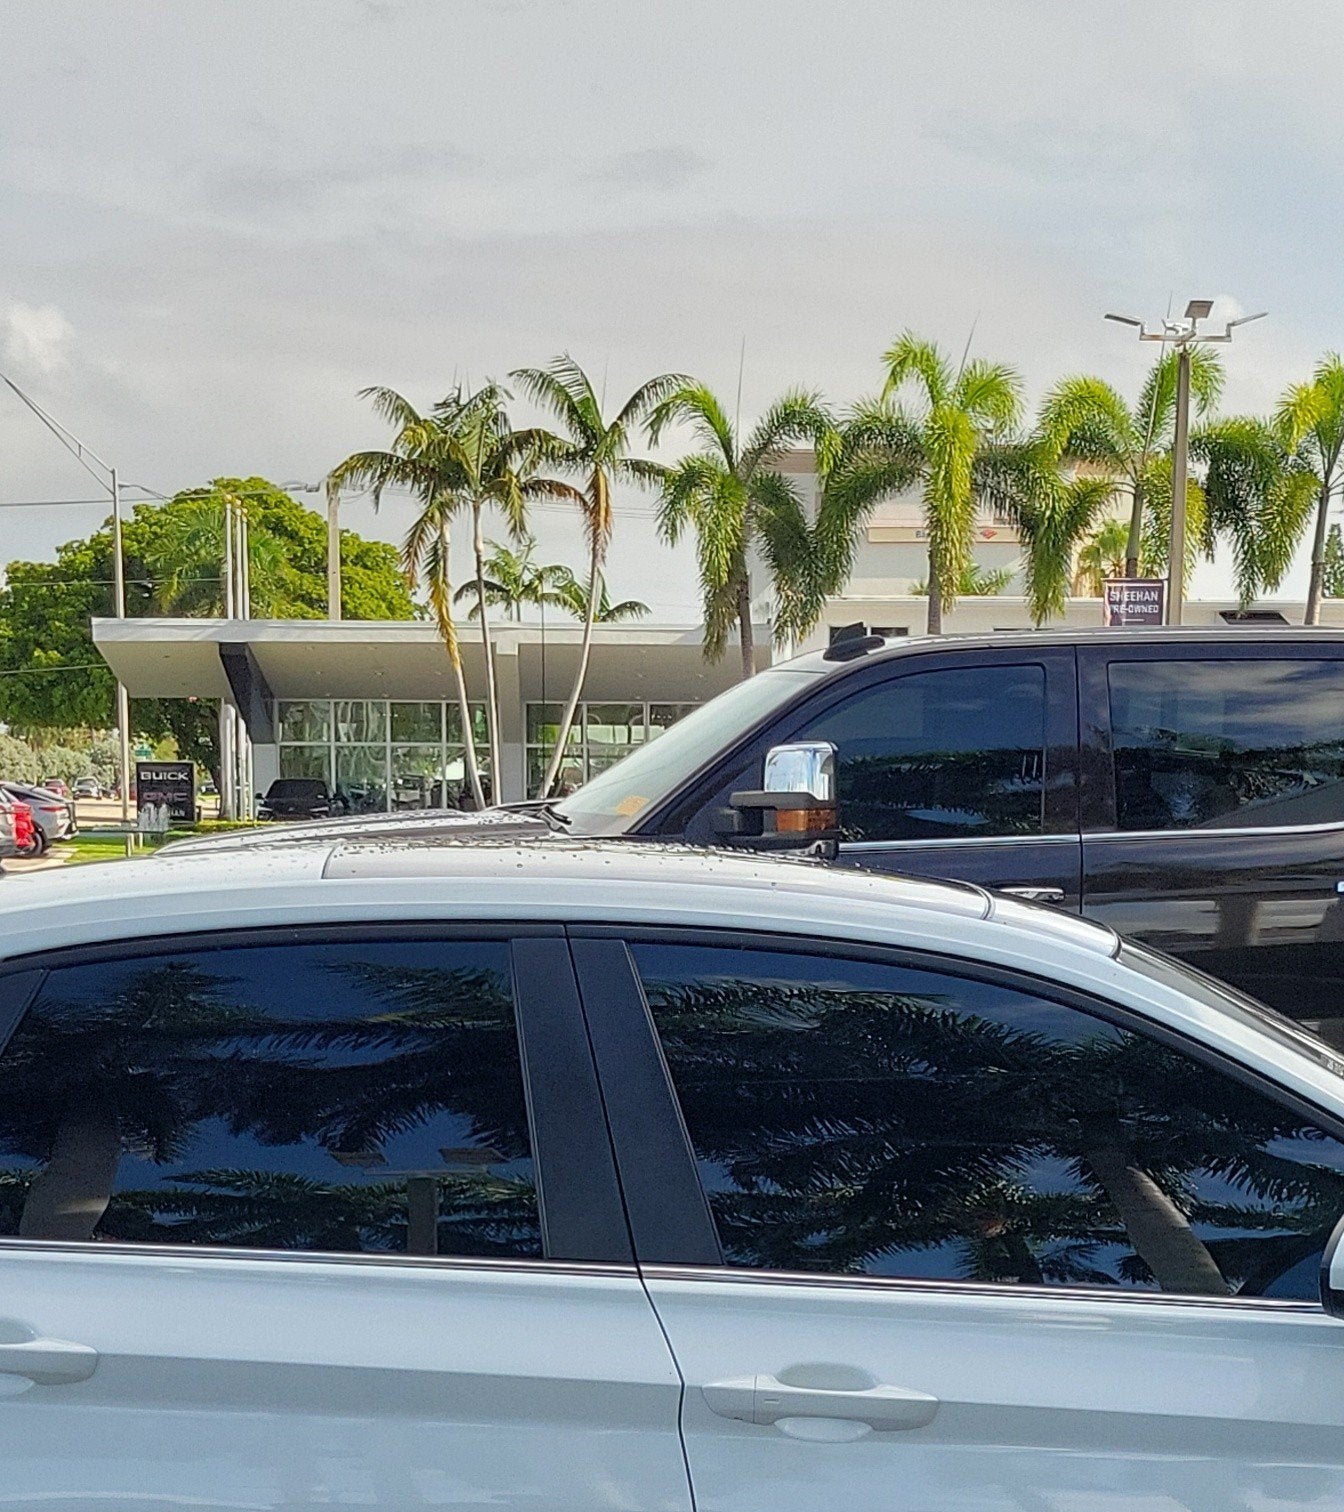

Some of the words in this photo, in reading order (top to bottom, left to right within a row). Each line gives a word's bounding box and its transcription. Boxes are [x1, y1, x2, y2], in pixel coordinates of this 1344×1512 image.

[1109, 590, 1158, 602] SHEEHAN
[140, 771, 189, 781] BUICK
[142, 792, 188, 802] GMC
